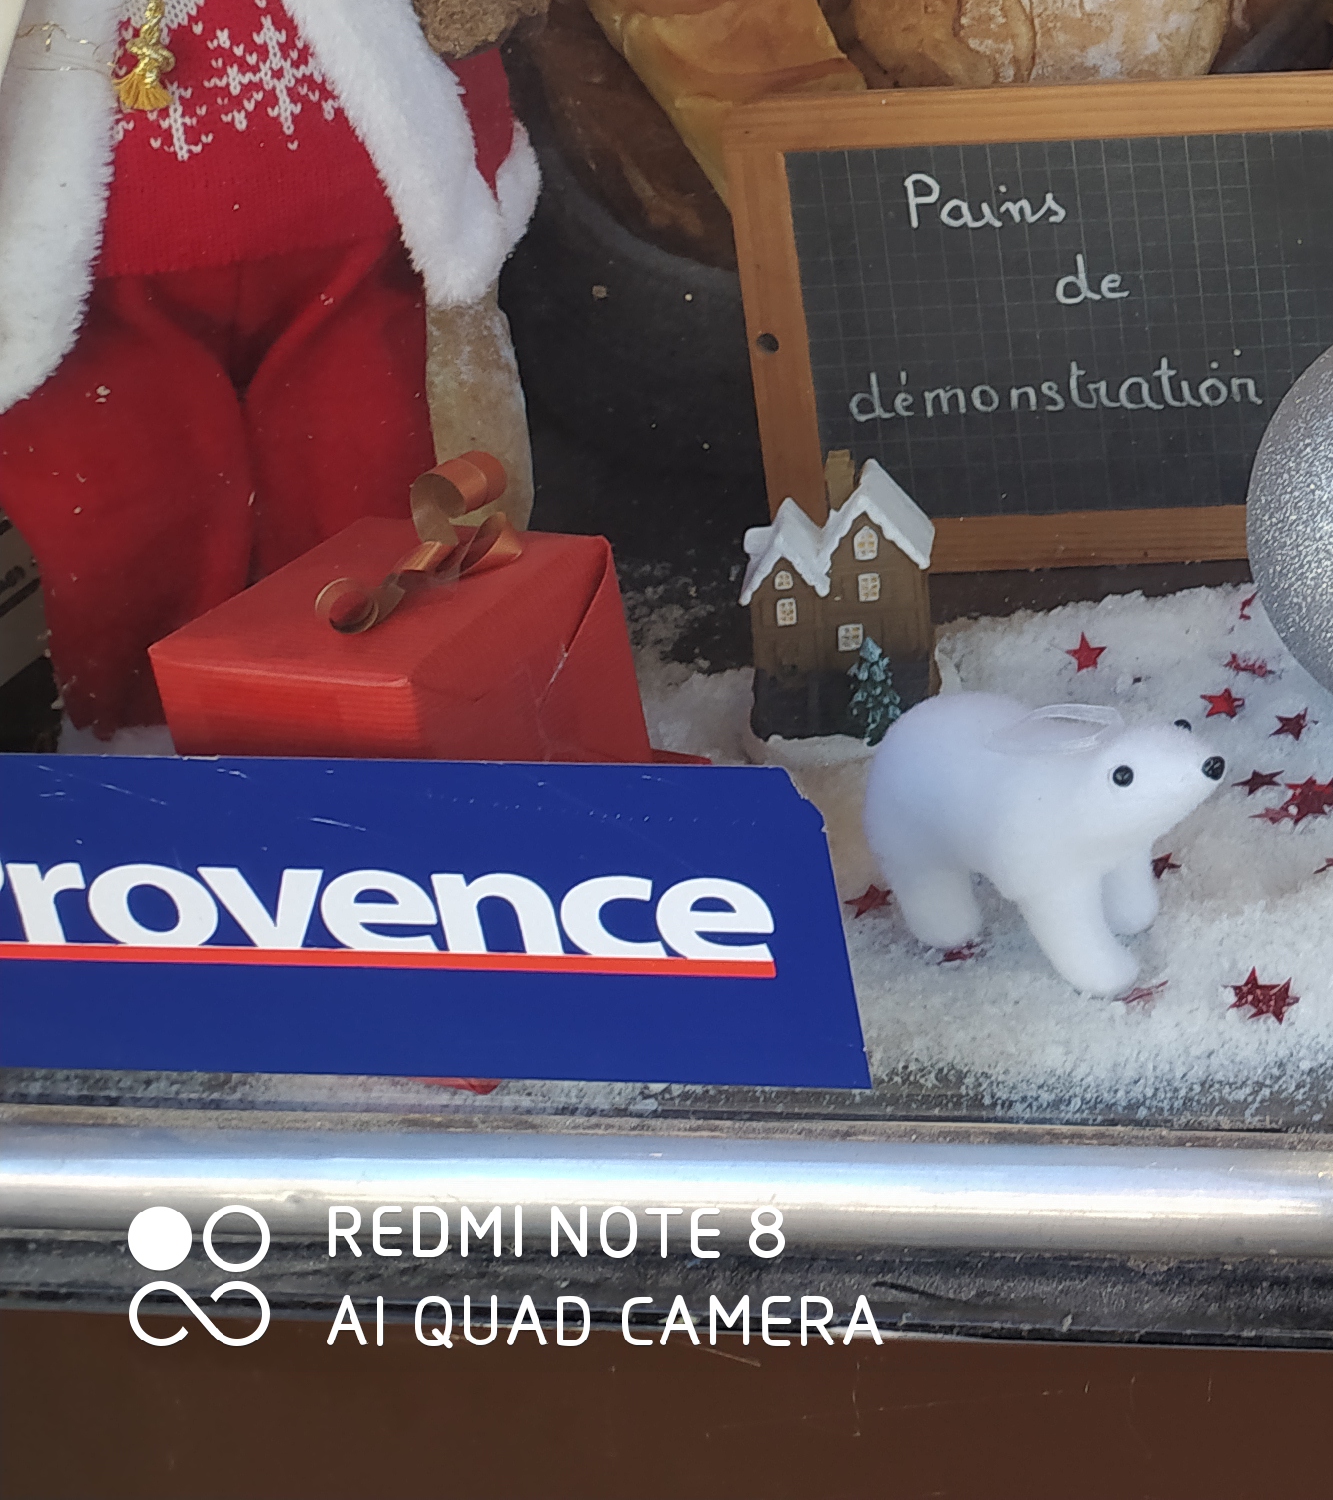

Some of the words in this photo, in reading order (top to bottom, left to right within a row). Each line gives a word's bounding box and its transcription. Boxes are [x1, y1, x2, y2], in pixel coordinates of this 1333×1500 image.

[904, 172, 1067, 229] Pains
[1055, 253, 1130, 304] de
[849, 356, 1263, 423] démonstration
[0, 861, 776, 961] rovence
